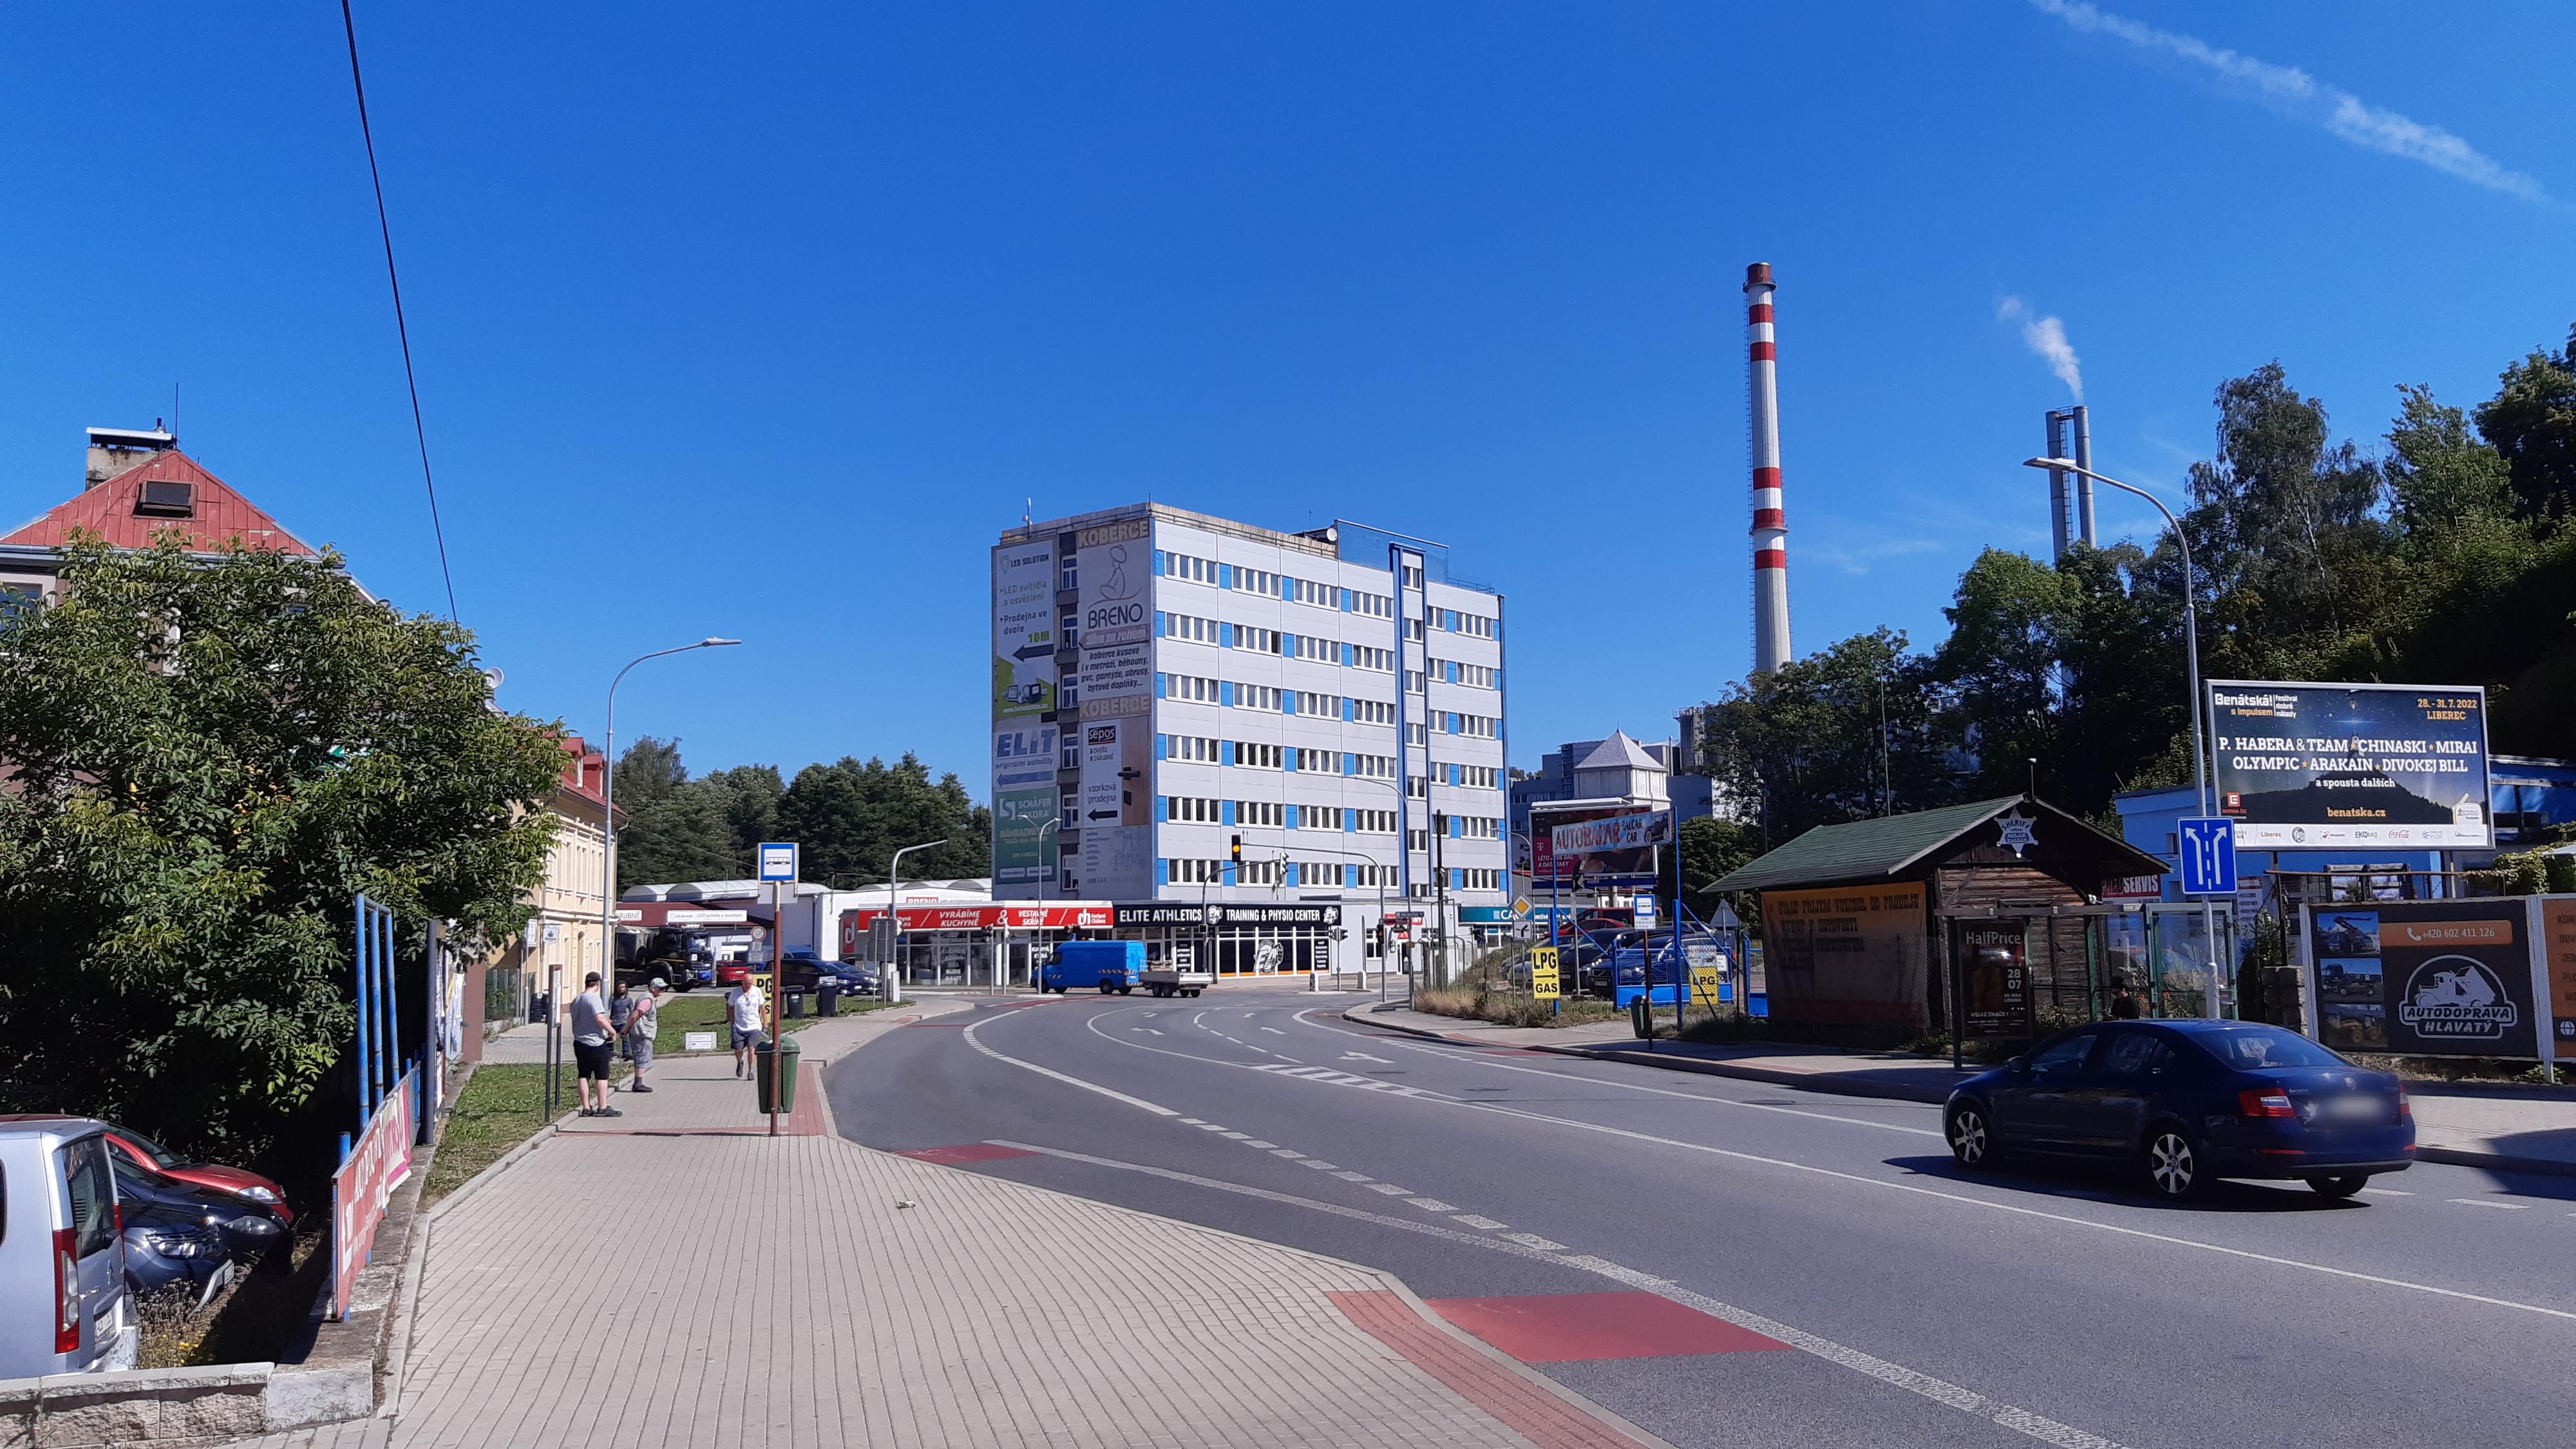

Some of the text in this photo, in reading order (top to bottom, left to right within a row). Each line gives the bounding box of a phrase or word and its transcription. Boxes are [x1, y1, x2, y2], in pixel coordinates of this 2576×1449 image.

[1079, 520, 1148, 547] KOBERCE
[1022, 554, 1049, 565] SOLUTION
[1005, 585, 1017, 594] LED
[1004, 612, 1036, 623] Prodejna
[1088, 603, 1142, 629] BRENO
[1004, 625, 1025, 635] dvoře
[1028, 630, 1050, 643] 10M
[1090, 646, 1140, 659] koberce kusové
[1118, 657, 1148, 667] běhouny,
[1095, 670, 1123, 681] garnýže,
[1126, 668, 1150, 677] ubrusy,
[1088, 682, 1110, 692] bytové
[2215, 693, 2273, 706] Benátská!
[2417, 699, 2430, 708] 28.
[2436, 699, 2447, 708] 31.
[2448, 699, 2455, 708] 7.
[2456, 699, 2477, 708] 2022
[1080, 696, 1150, 717] KOBERCE
[2427, 710, 2467, 720] LIBEREC
[1089, 728, 1115, 741] sepos
[2219, 737, 2477, 753] P. HABERA & TEAM CHINASKI MIRAI
[2233, 757, 2468, 773] OLYMPIC ARAKAIN DIVOKEJ BILL
[1088, 782, 1116, 792] vzorková
[2323, 779, 2360, 789] spousta
[2362, 777, 2395, 787] dalších
[1018, 797, 1052, 809] SCHÄFER
[1088, 794, 1116, 804] prodejna
[1019, 810, 1049, 819] KORA
[2327, 806, 2386, 818] benatska.cz
[2002, 820, 2030, 830] SHERIFF
[1555, 822, 1620, 850] AUTOBAZAR
[1627, 831, 1637, 843] CAR
[940, 909, 981, 918] VYRÁBÍME
[998, 909, 1008, 924] &
[1018, 909, 1048, 917] VESTAVNÉ
[1119, 909, 1202, 922] ELITE ATHLETICS
[1226, 909, 1320, 921] TRAINING & PHYSIO CENTER
[941, 918, 979, 927] KUCHYNĚ
[1965, 931, 2022, 945] HalfPrice
[2423, 928, 2495, 938] +420 602 411 126
[1533, 952, 1557, 969] LPG
[2007, 969, 2021, 978] 28
[757, 978, 772, 994] PG
[1693, 977, 1716, 985] LPG
[2008, 979, 2022, 989] 07
[1535, 983, 1558, 993] GAS
[2407, 1007, 2509, 1018] AUTODOPRAVA
[2425, 1019, 2492, 1033] HLAVATÝ
